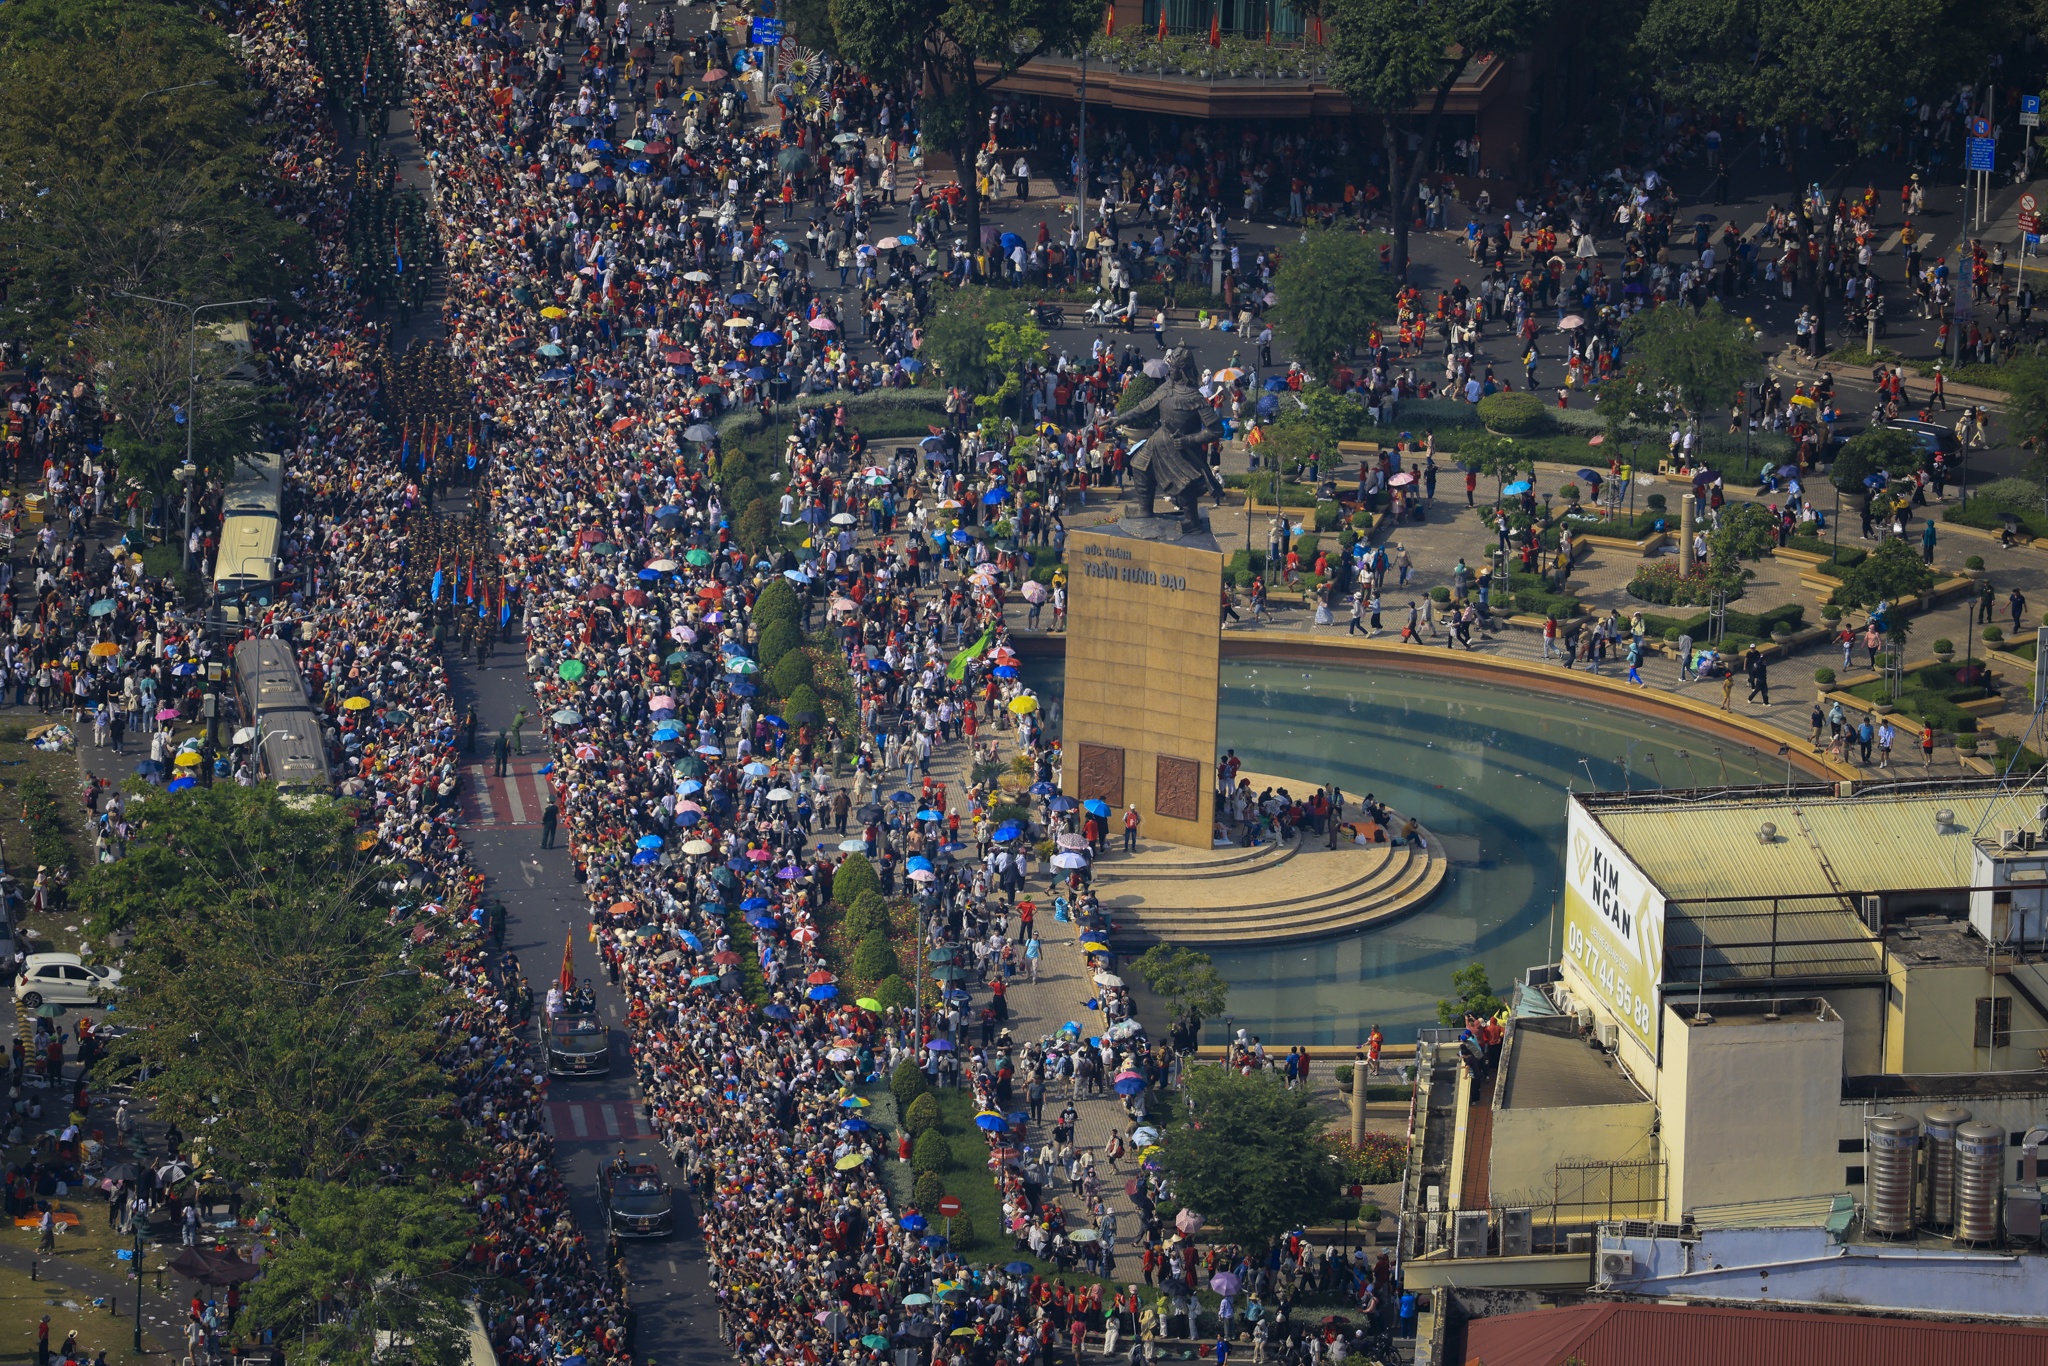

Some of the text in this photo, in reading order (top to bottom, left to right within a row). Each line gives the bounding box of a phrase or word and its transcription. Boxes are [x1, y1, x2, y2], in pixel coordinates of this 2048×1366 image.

[2027, 99, 2036, 109] P
[1084, 544, 1132, 560] ĐỨC THÁNH
[1083, 561, 1186, 593] TRẦN HƯNG ĐẠO
[1593, 846, 1619, 896] KIM
[1592, 875, 1631, 940] NGAN
[1568, 920, 1650, 1035] 09 77 44 55 88
